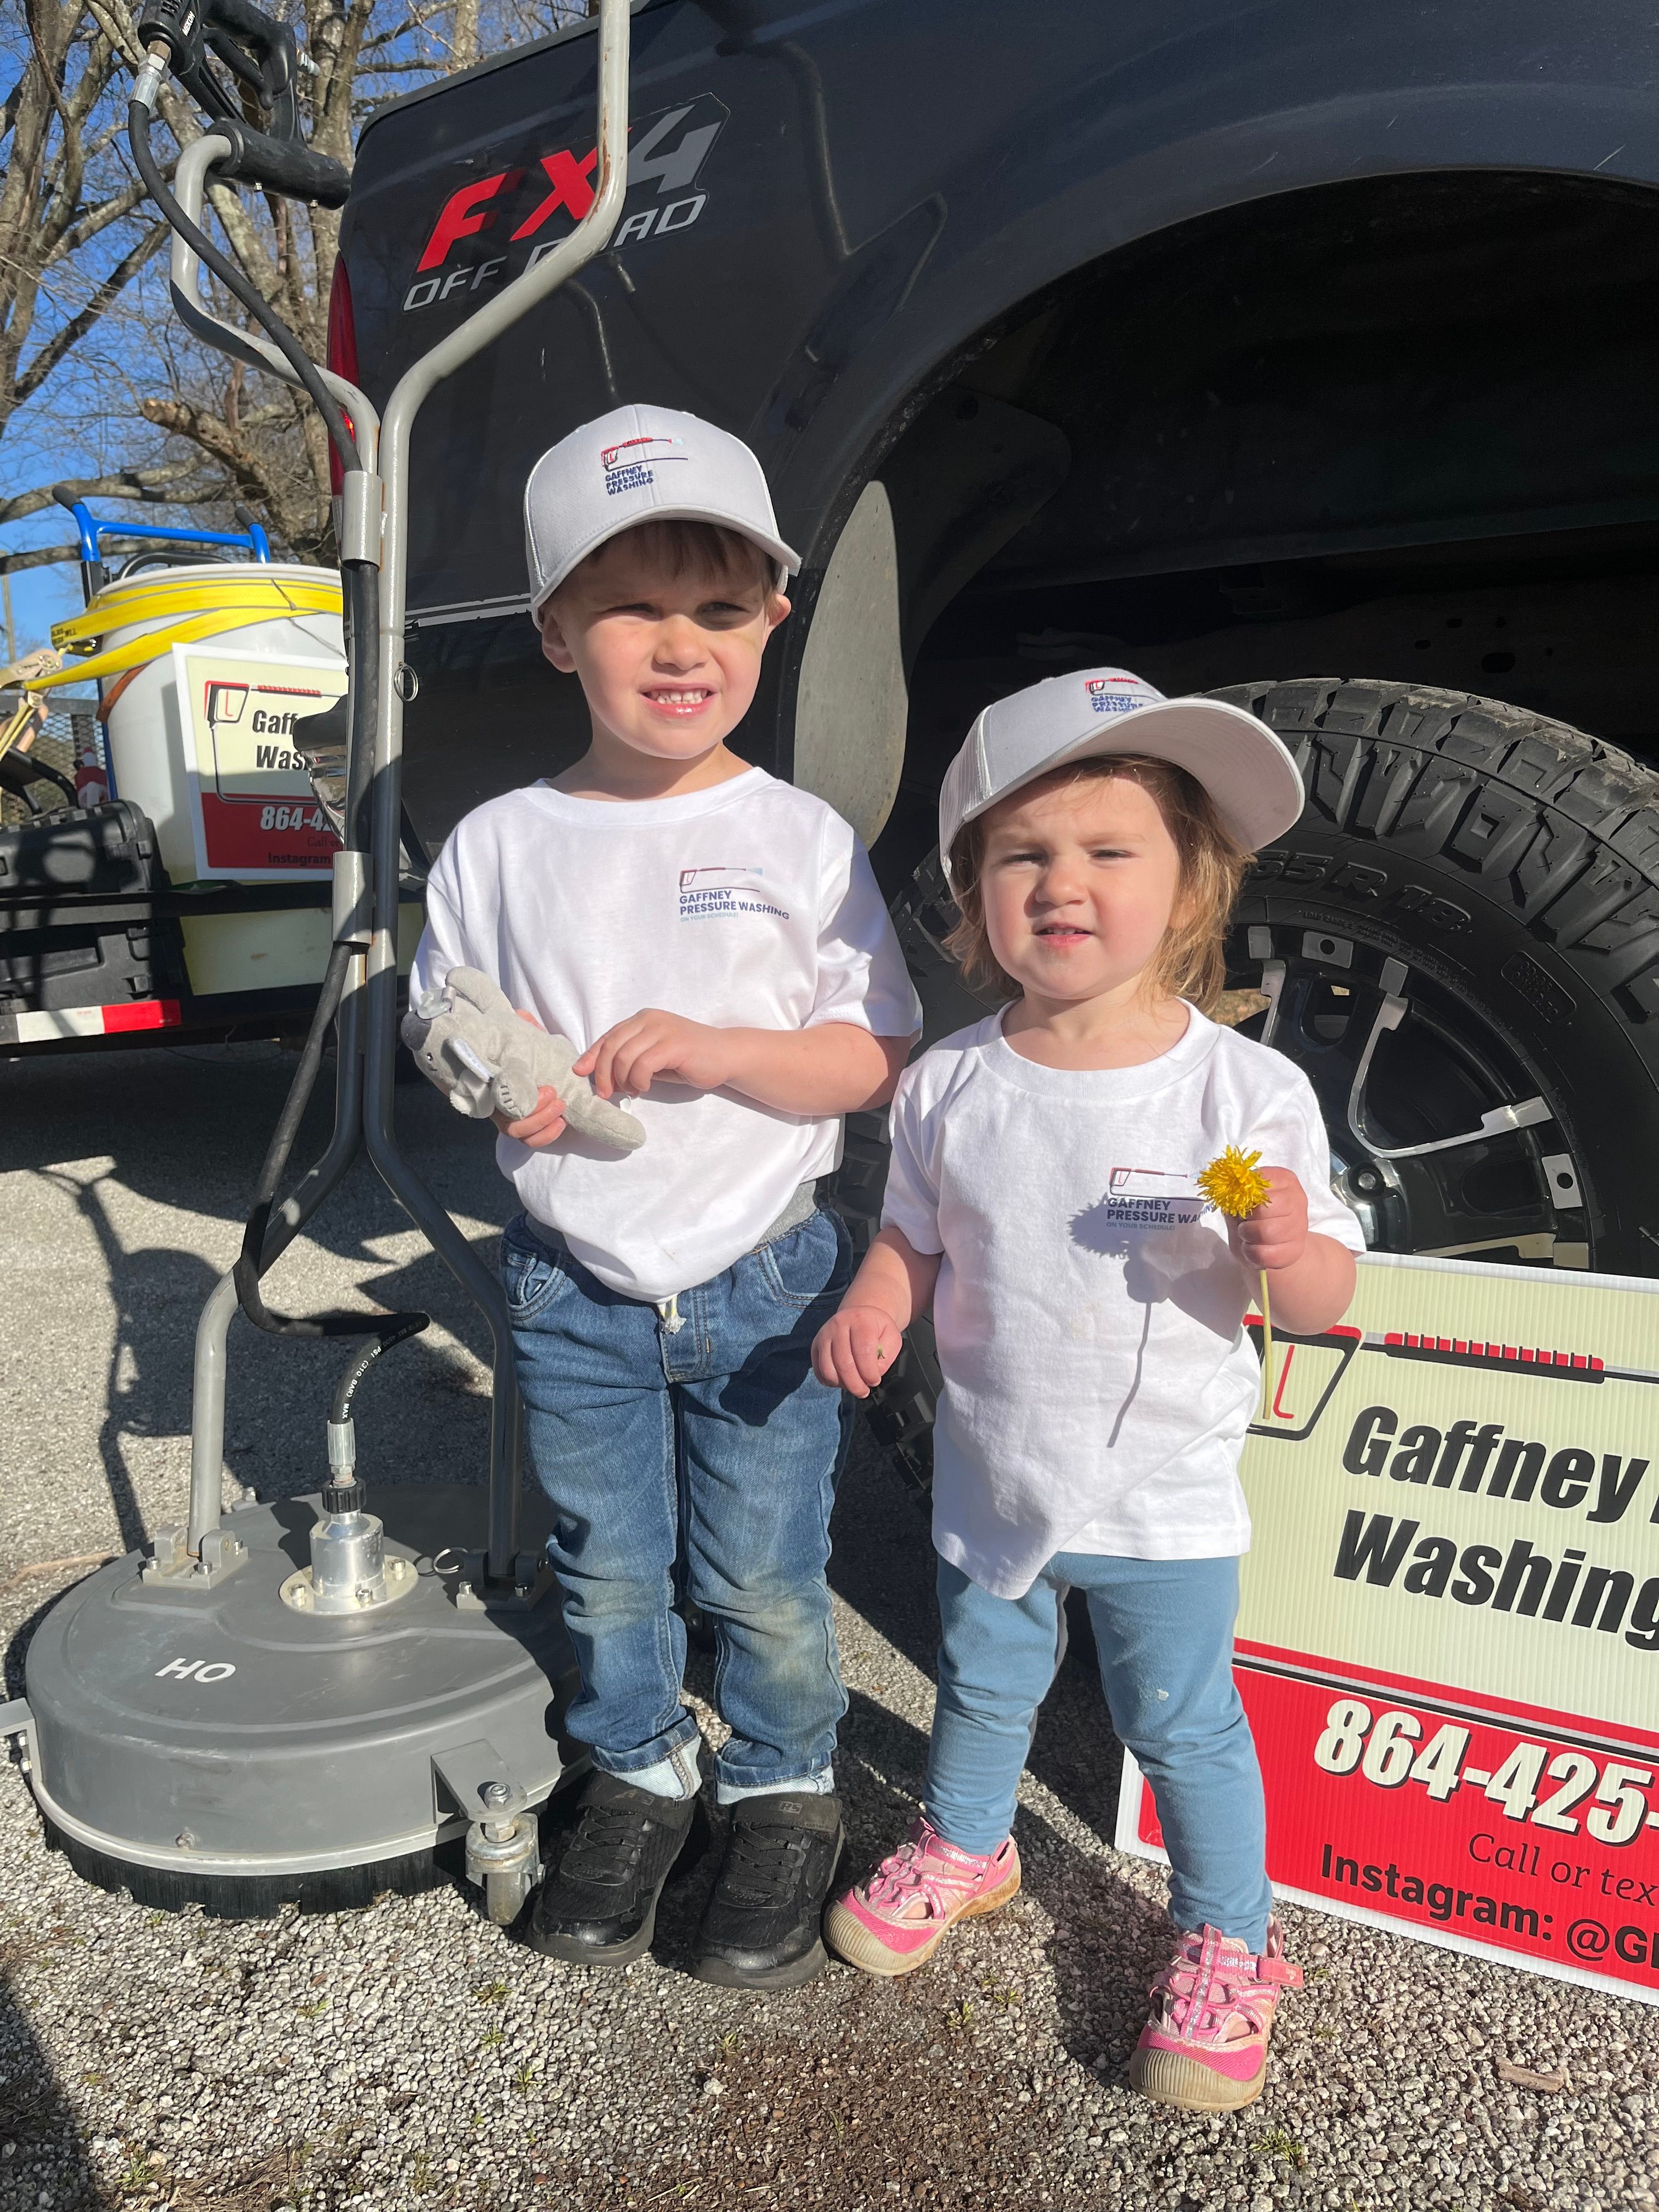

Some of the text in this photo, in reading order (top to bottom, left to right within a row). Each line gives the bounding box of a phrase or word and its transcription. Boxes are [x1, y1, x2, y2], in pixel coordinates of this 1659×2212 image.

[417, 105, 721, 273] FX4
[403, 194, 707, 311] OFF AD
[605, 465, 643, 482] GAFFNEY
[606, 470, 654, 490] PRESSURE
[607, 478, 654, 496] WASHING
[252, 710, 298, 735] Gaff
[256, 745, 307, 770] Was
[307, 837, 328, 847] Call
[679, 890, 732, 904] GAFFNEY
[680, 901, 790, 919] PRESSURE WASHING
[1107, 1197, 1171, 1211] GAFFNEY
[1107, 1209, 1175, 1223] PRESSURE
[370, 1346, 382, 1358] PSI
[356, 1360, 369, 1377] (310
[346, 1379, 358, 1397] BAR)
[342, 1403, 350, 1419] MAX
[1342, 1406, 1650, 1523] Gaffney
[1333, 1509, 1659, 1651] Washing
[154, 1657, 236, 1683] HO
[1469, 1832, 1659, 1906] Call or tex
[1321, 1843, 1553, 1941] Instagram:
